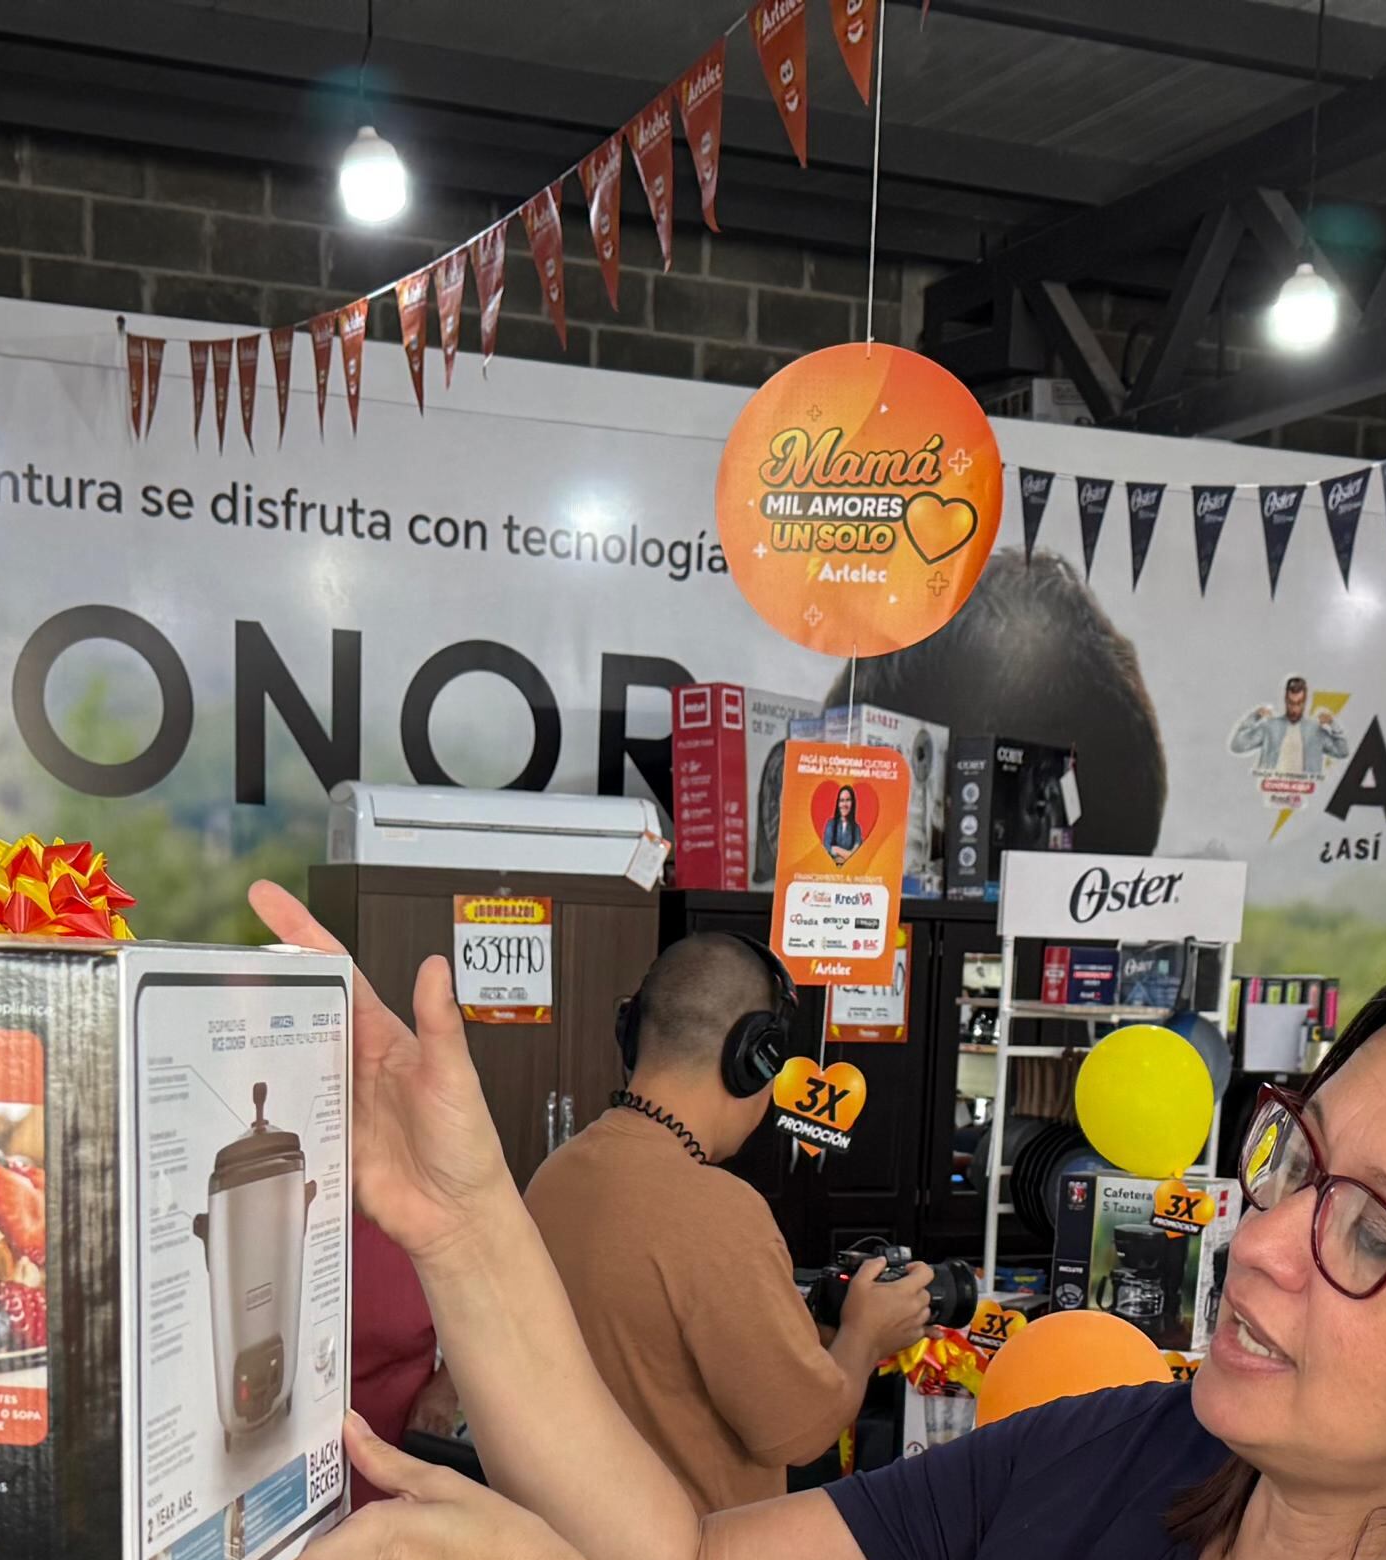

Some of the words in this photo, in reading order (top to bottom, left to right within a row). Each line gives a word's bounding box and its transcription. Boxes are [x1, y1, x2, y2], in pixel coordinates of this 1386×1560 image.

[686, 62, 723, 104] Artelec
[759, 427, 945, 488] Mamá
[766, 494, 803, 517] MIL
[807, 496, 904, 519] AMORES
[1131, 486, 1159, 511] Oster
[1196, 489, 1229, 517] Oster
[1263, 490, 1297, 518] Oster
[1327, 477, 1363, 510] Oster
[141, 484, 195, 520] se
[211, 482, 391, 542] disfruta
[408, 512, 488, 551] con
[503, 514, 730, 582] tecnología
[771, 521, 812, 553] UN
[815, 522, 897, 555] SOLO
[817, 561, 888, 584] Artelec
[1319, 831, 1382, 865] ¿ASÍ
[1068, 866, 1185, 924] Oster
[814, 959, 852, 977] Artelec
[1124, 957, 1154, 977] Oster
[794, 1076, 851, 1123] 3X
[776, 1114, 852, 1150] PROMOCIÓN
[1103, 1186, 1154, 1202] Cafetera
[1115, 1202, 1143, 1215] Tazas
[1164, 1194, 1202, 1221] 3X
[979, 1313, 1015, 1338] 3X
[310, 1439, 340, 1478] BLACK+
[310, 1462, 340, 1505] DECKER
